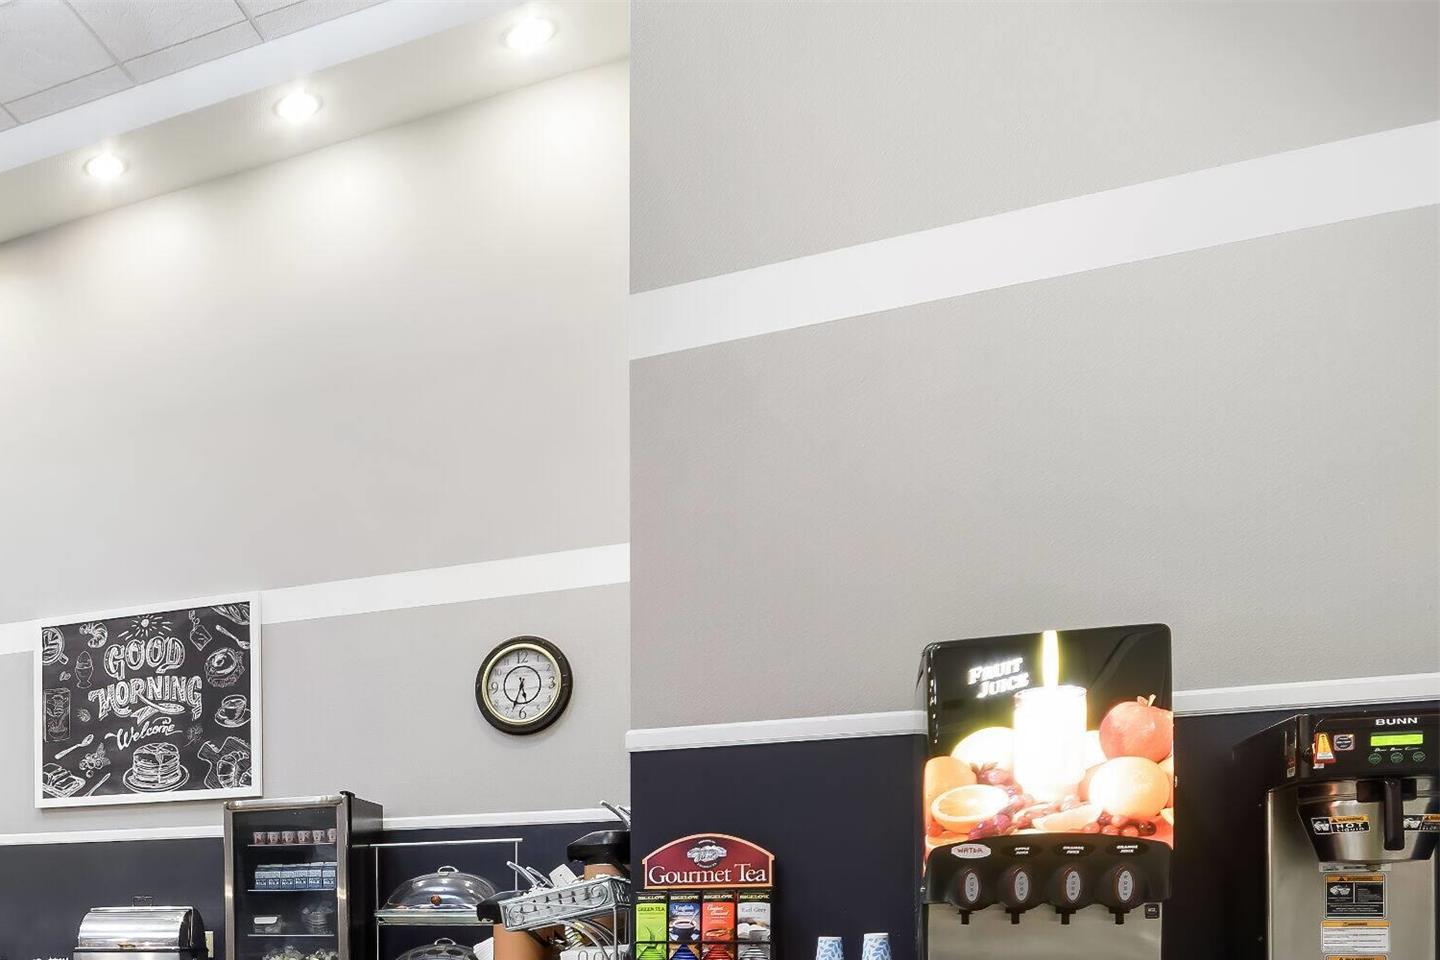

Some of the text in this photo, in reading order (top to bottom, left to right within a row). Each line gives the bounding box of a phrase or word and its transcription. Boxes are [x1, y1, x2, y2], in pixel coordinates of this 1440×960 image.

[104, 635, 185, 680] GOOD
[517, 650, 529, 664] 12
[490, 682, 499, 694] 9
[548, 676, 556, 689] 3
[976, 672, 1030, 699] JUICE
[88, 675, 203, 724] MORNING
[518, 706, 527, 720] 6
[1375, 717, 1418, 726] BUNN
[104, 717, 183, 750] Welcome
[648, 863, 767, 884] Gourmet Tea
